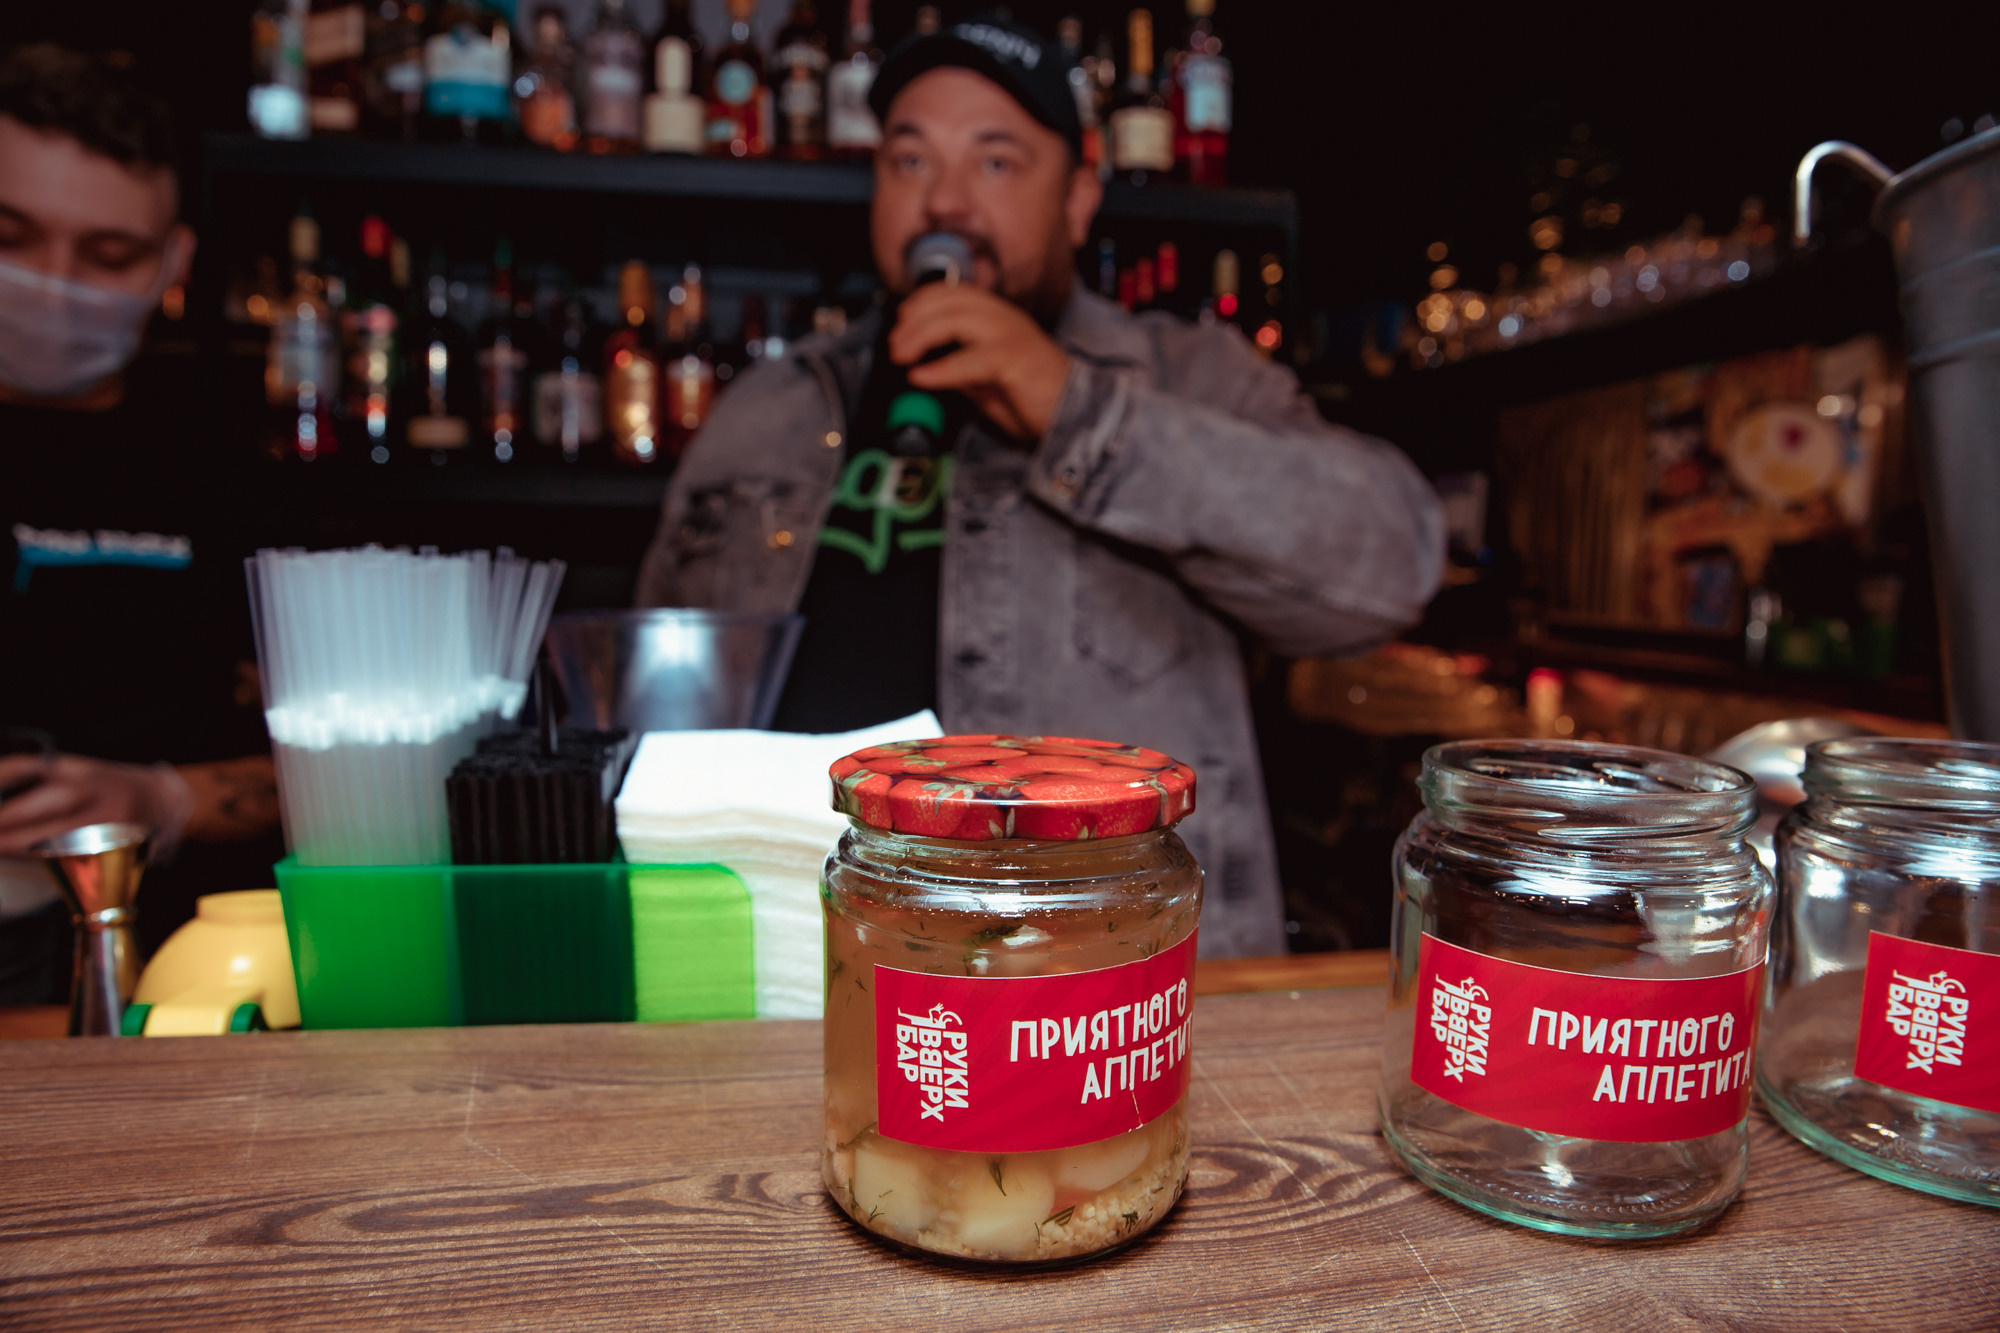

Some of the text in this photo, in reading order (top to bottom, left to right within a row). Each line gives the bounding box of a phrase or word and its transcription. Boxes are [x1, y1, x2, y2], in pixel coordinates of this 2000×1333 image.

[1010, 977, 1188, 1062] ПРИЯТНОГО
[1430, 987, 1450, 1042] БАР
[1464, 1002, 1492, 1076] РУКИ
[1528, 1007, 1735, 1057] ПРИЯТНОГО
[1886, 983, 1914, 1036] БАР
[1935, 995, 1969, 1066] РУКИ
[896, 1023, 919, 1082] БАР
[943, 1031, 969, 1109] РУКИ
[1592, 1046, 1752, 1104] АППЕТИТА
